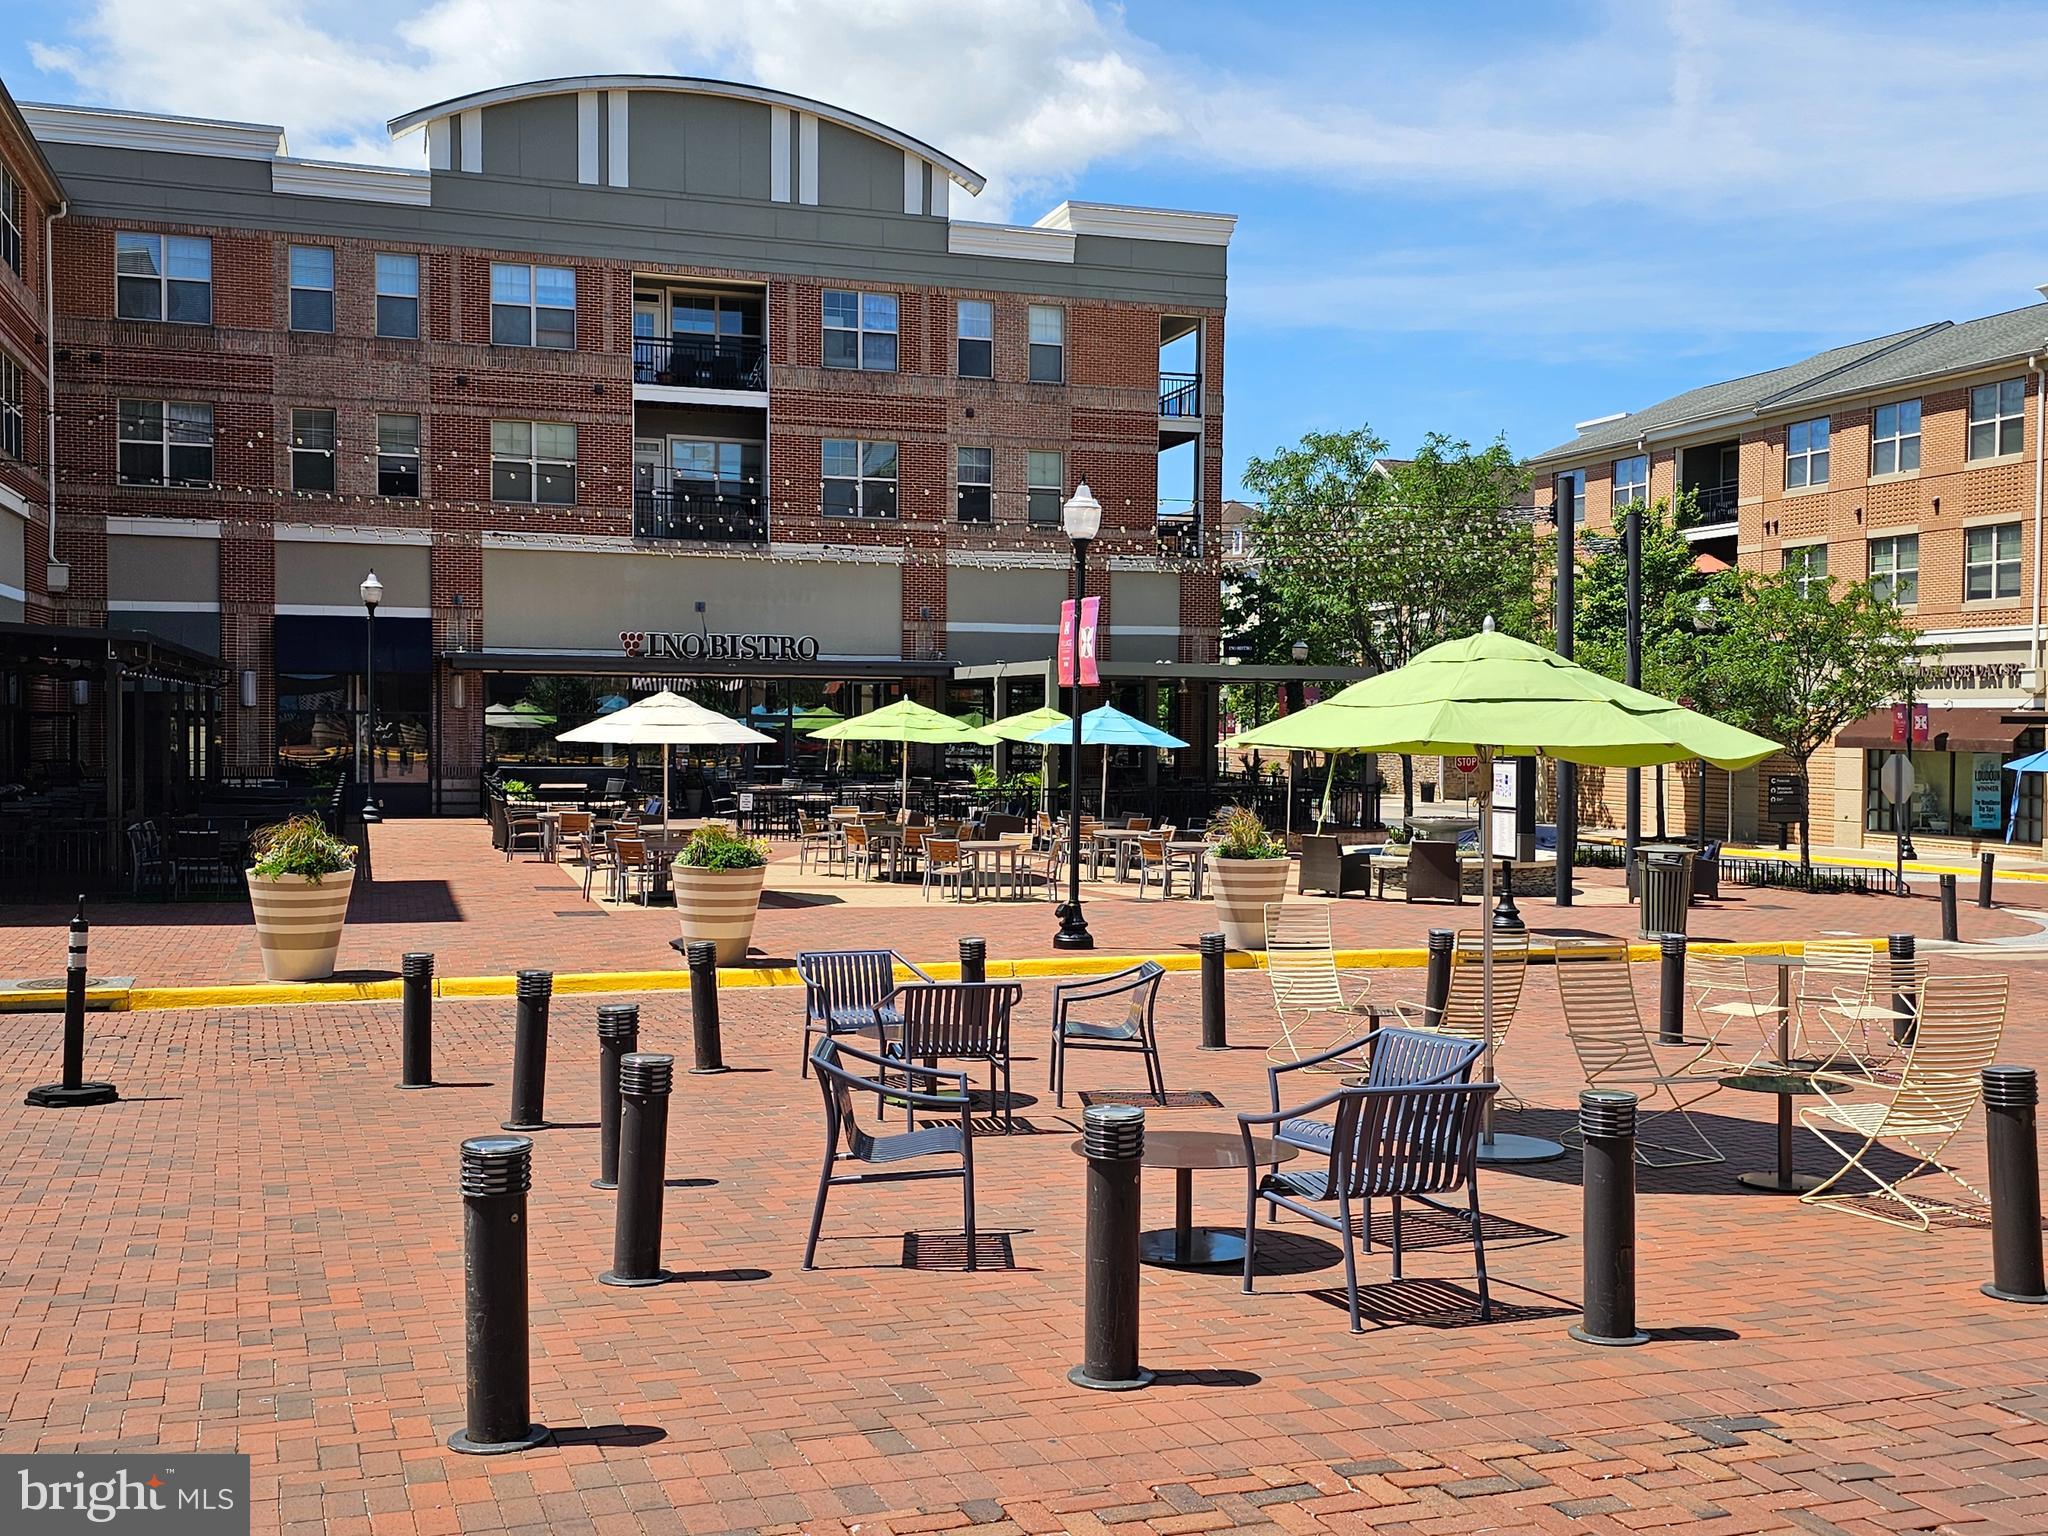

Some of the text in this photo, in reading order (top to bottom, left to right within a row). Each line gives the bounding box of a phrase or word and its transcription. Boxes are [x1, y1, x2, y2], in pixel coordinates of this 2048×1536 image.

[644, 632, 820, 661] INO BISTRO
[1457, 757, 1477, 767] STOP
